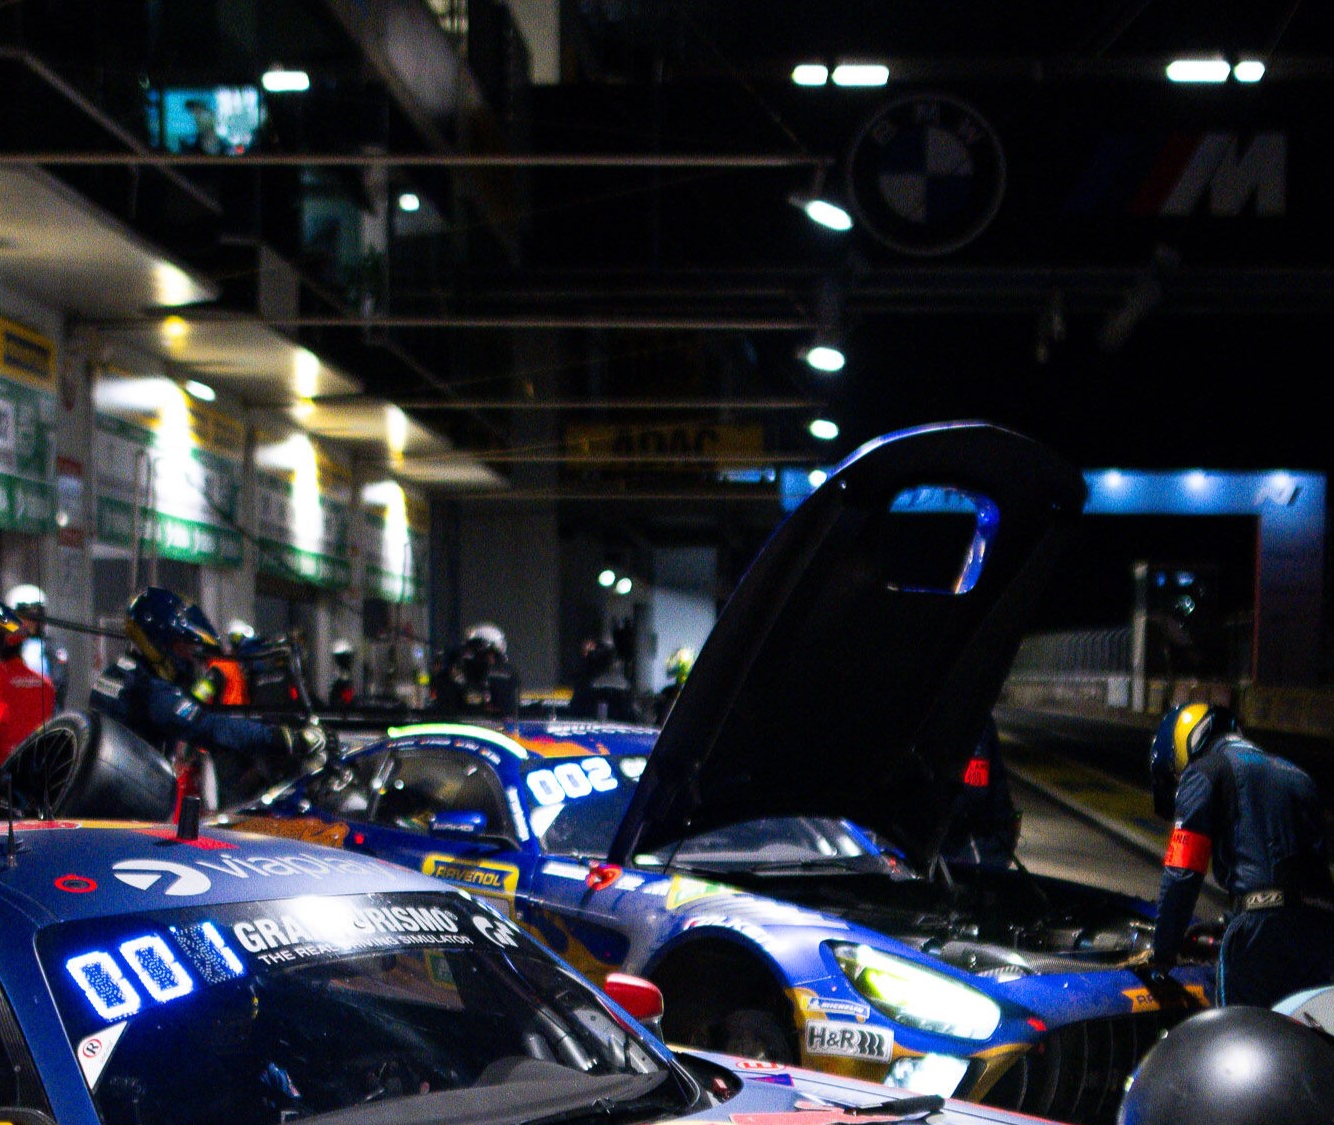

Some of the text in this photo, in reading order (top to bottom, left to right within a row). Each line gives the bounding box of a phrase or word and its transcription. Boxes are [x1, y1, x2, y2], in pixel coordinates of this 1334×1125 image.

[526, 756, 618, 807] 002
[196, 851, 397, 882] viaplay
[435, 865, 504, 887] RAVENOL
[258, 949, 297, 966] THE
[400, 933, 474, 948] SIMULATOR
[808, 1024, 856, 1051] H&R
